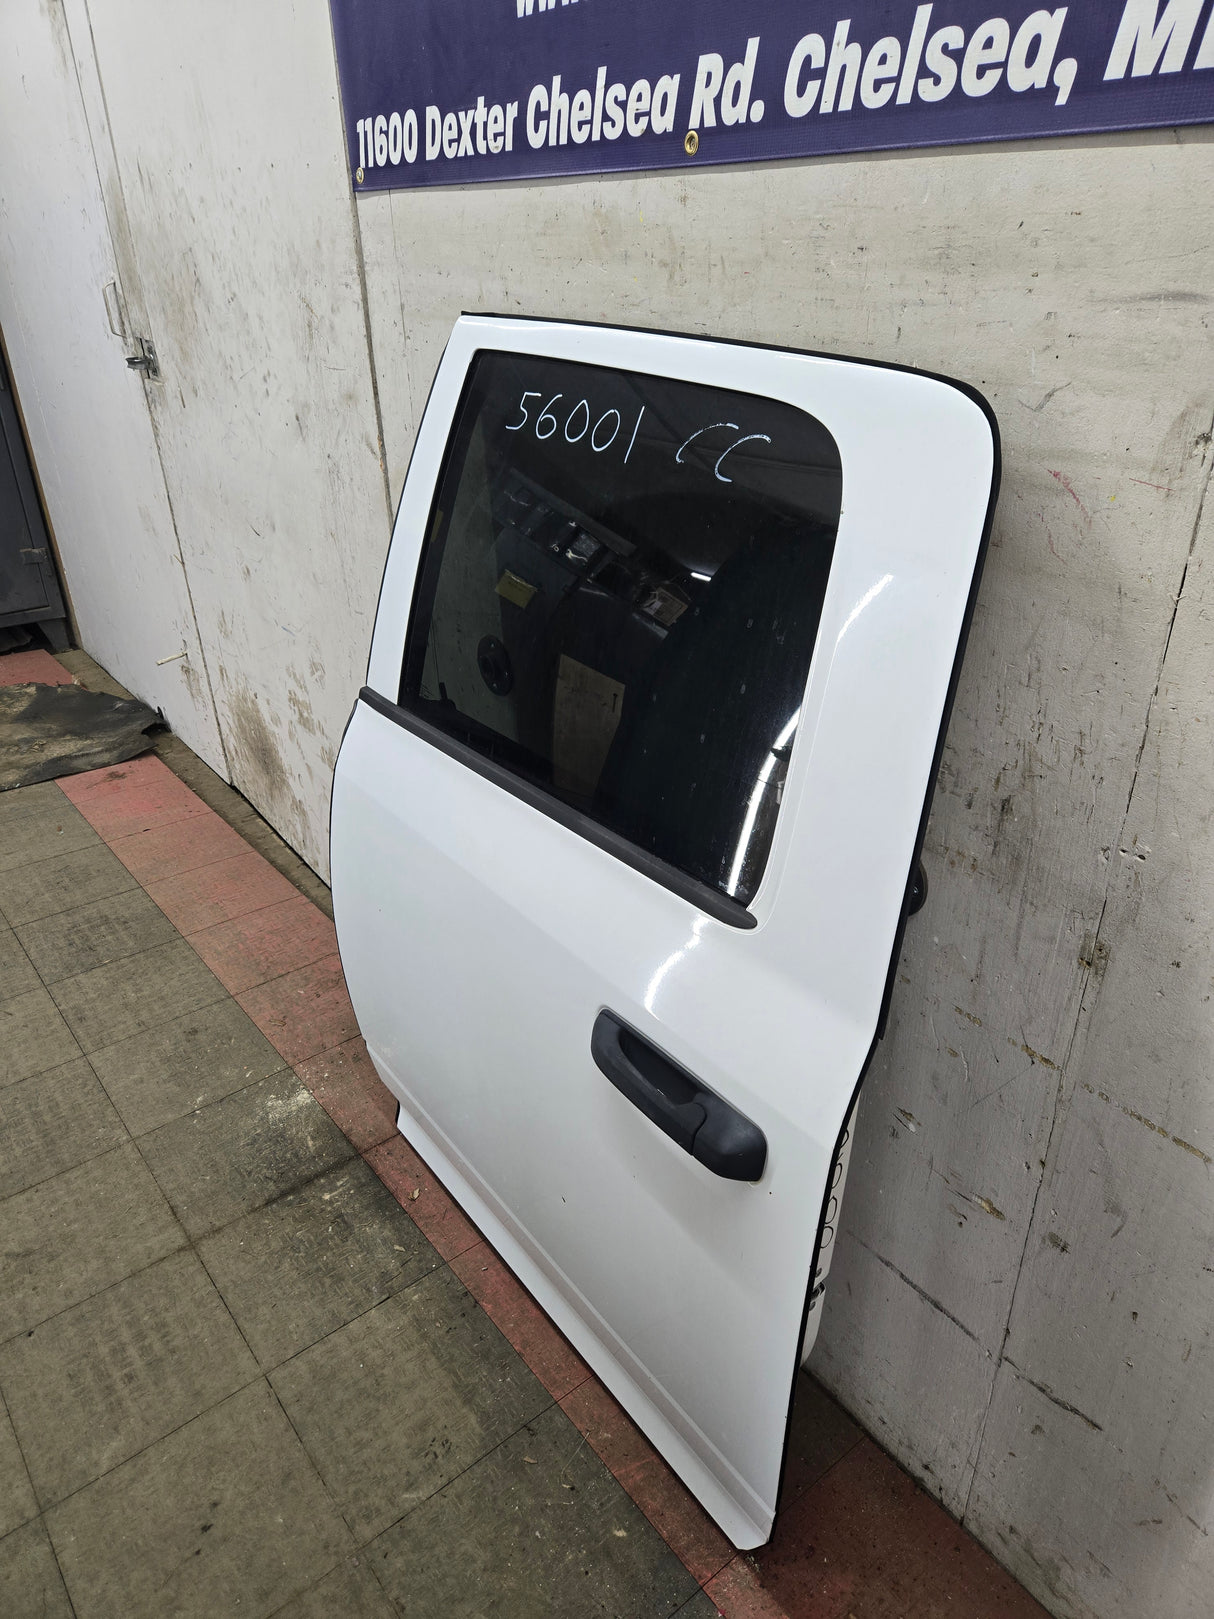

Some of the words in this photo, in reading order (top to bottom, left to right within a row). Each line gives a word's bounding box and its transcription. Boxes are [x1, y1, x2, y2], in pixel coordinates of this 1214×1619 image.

[356, 109, 418, 168] 11600
[426, 96, 519, 160] Dexter
[526, 66, 681, 149] Chelsea
[688, 37, 765, 130] Rd.
[784, 3, 1078, 118] Chelsea,
[506, 391, 645, 464] 56001
